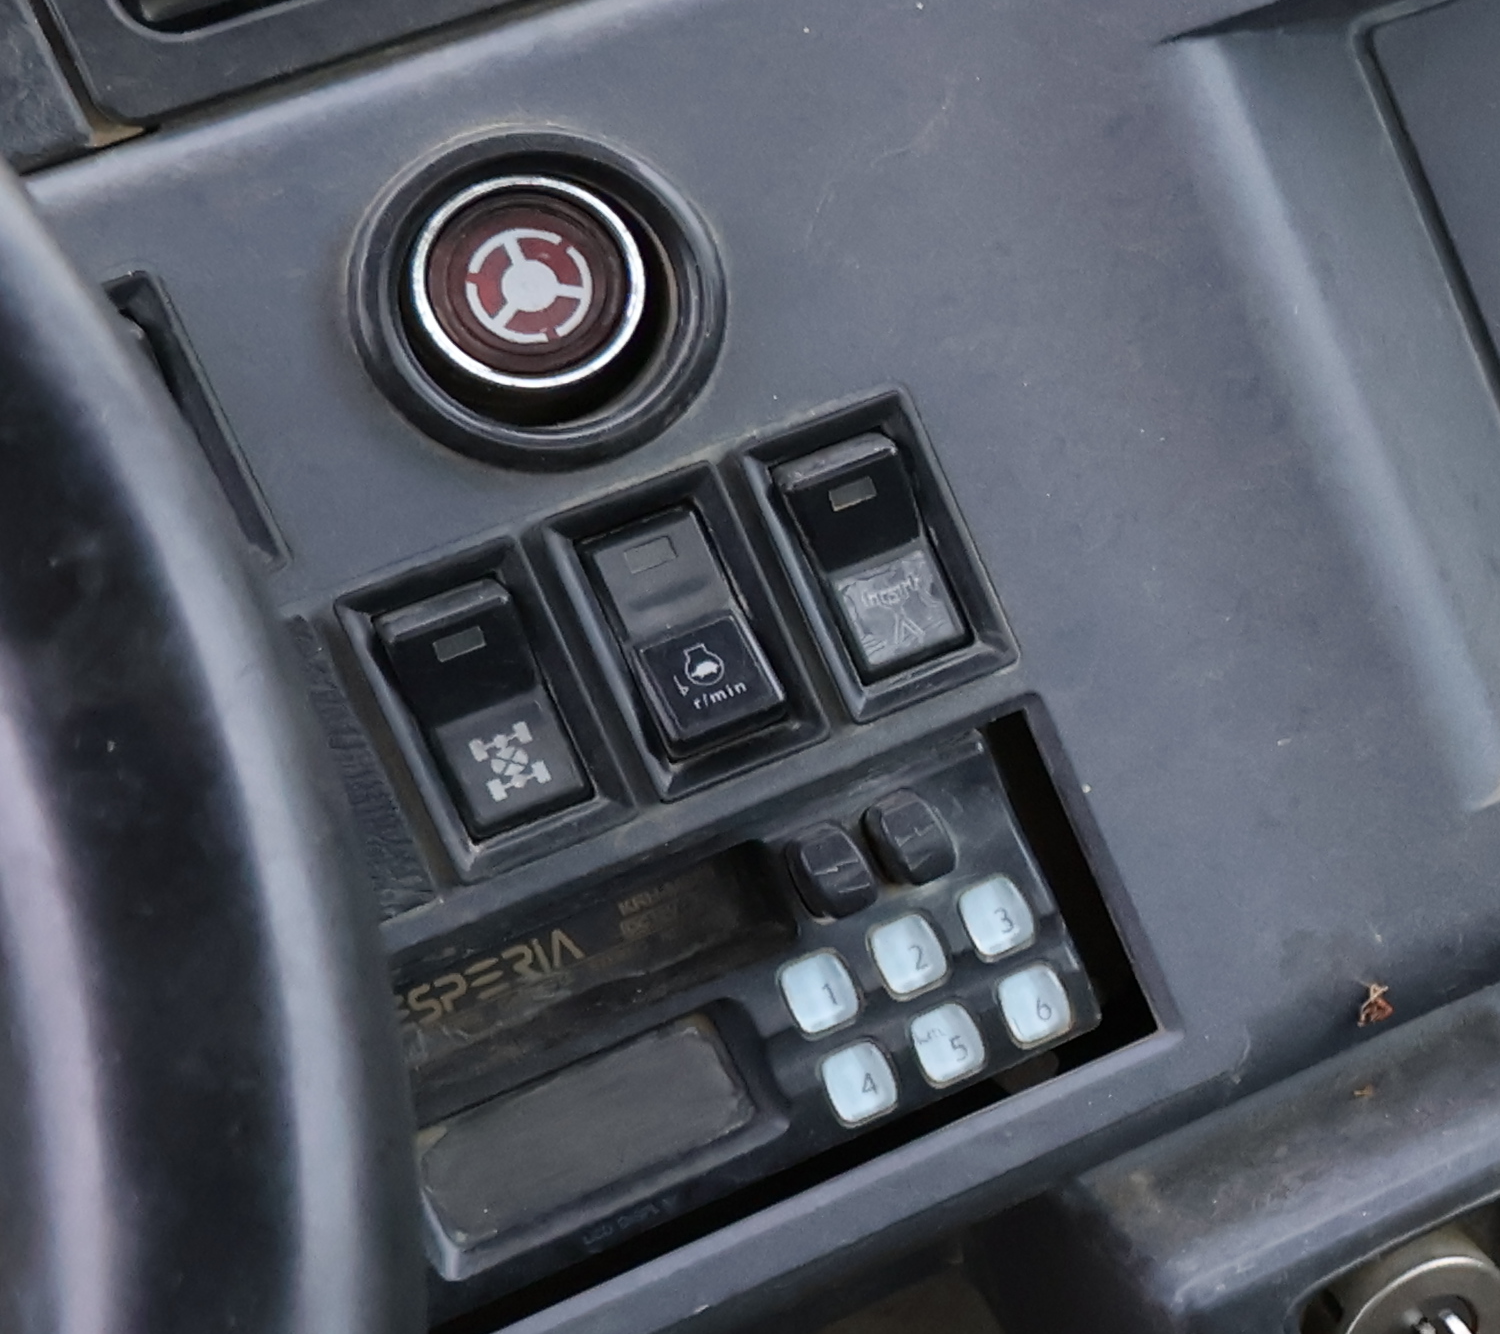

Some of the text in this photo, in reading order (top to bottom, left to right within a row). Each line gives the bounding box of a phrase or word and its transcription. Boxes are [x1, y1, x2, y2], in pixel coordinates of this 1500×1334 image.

[693, 681, 748, 710] r/min
[993, 907, 1015, 934] 3
[907, 944, 928, 972] 2
[821, 982, 839, 1006] 1
[1035, 996, 1053, 1021] 6
[949, 1035, 969, 1063] 5
[861, 1071, 878, 1096] 4
